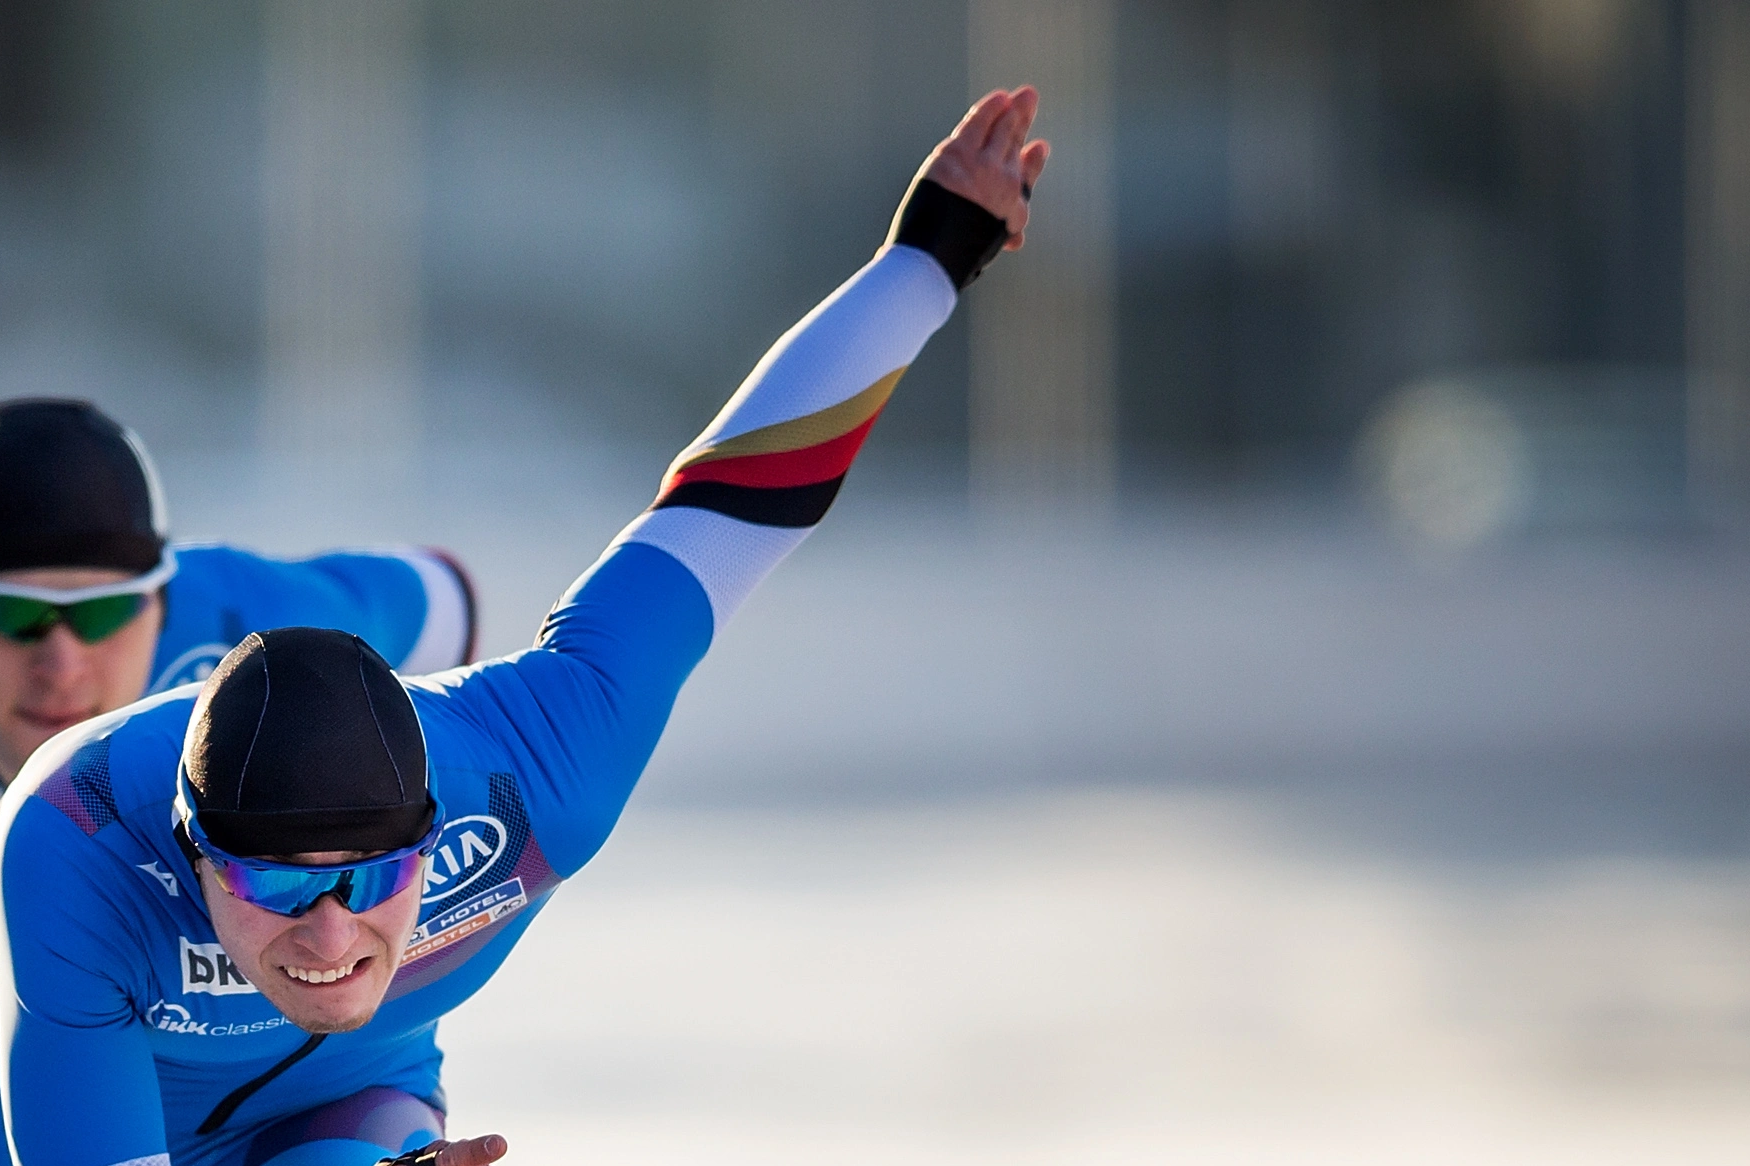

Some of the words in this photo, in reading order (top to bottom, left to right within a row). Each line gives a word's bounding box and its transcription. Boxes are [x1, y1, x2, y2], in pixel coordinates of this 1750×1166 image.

[421, 829, 494, 896] KIA
[439, 891, 508, 928] HOTEL
[402, 919, 485, 961] HOSTEL
